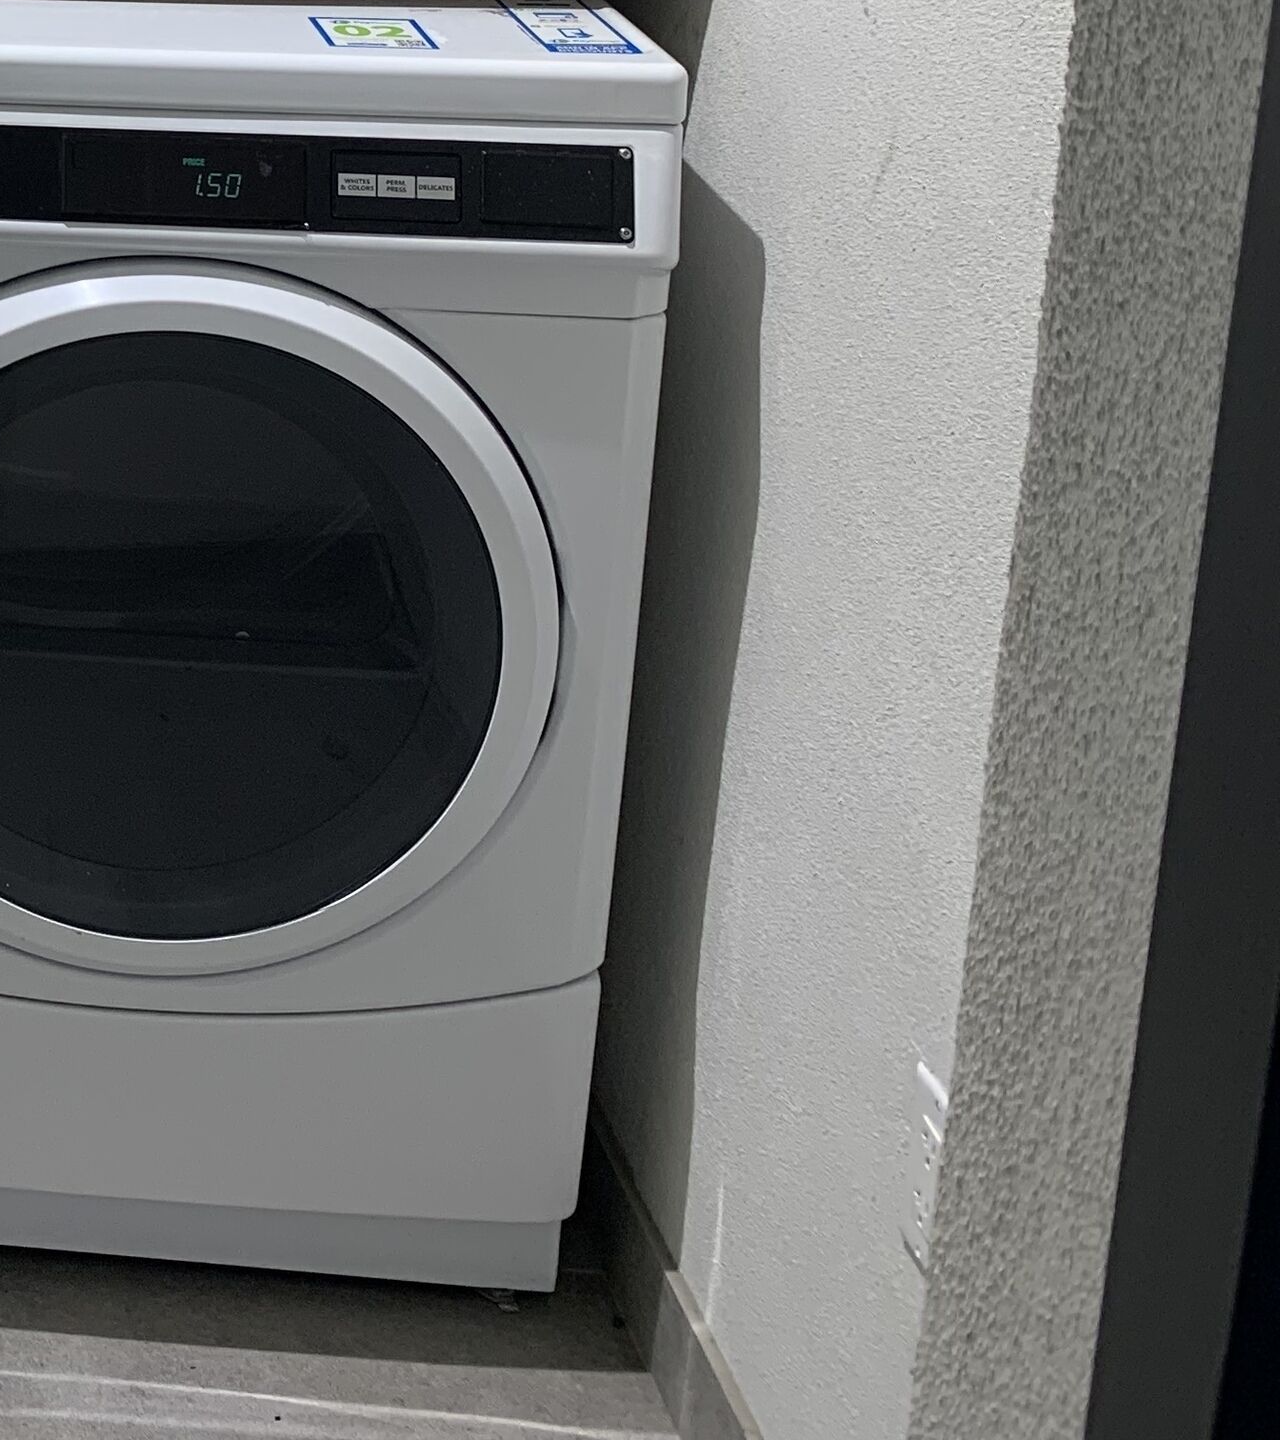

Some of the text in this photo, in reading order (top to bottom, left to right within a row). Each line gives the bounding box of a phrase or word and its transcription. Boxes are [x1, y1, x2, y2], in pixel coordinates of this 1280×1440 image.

[333, 25, 413, 38] 02
[195, 173, 242, 198] 1.50
[348, 184, 374, 192] COLORS
[418, 184, 454, 192] DELICATES
